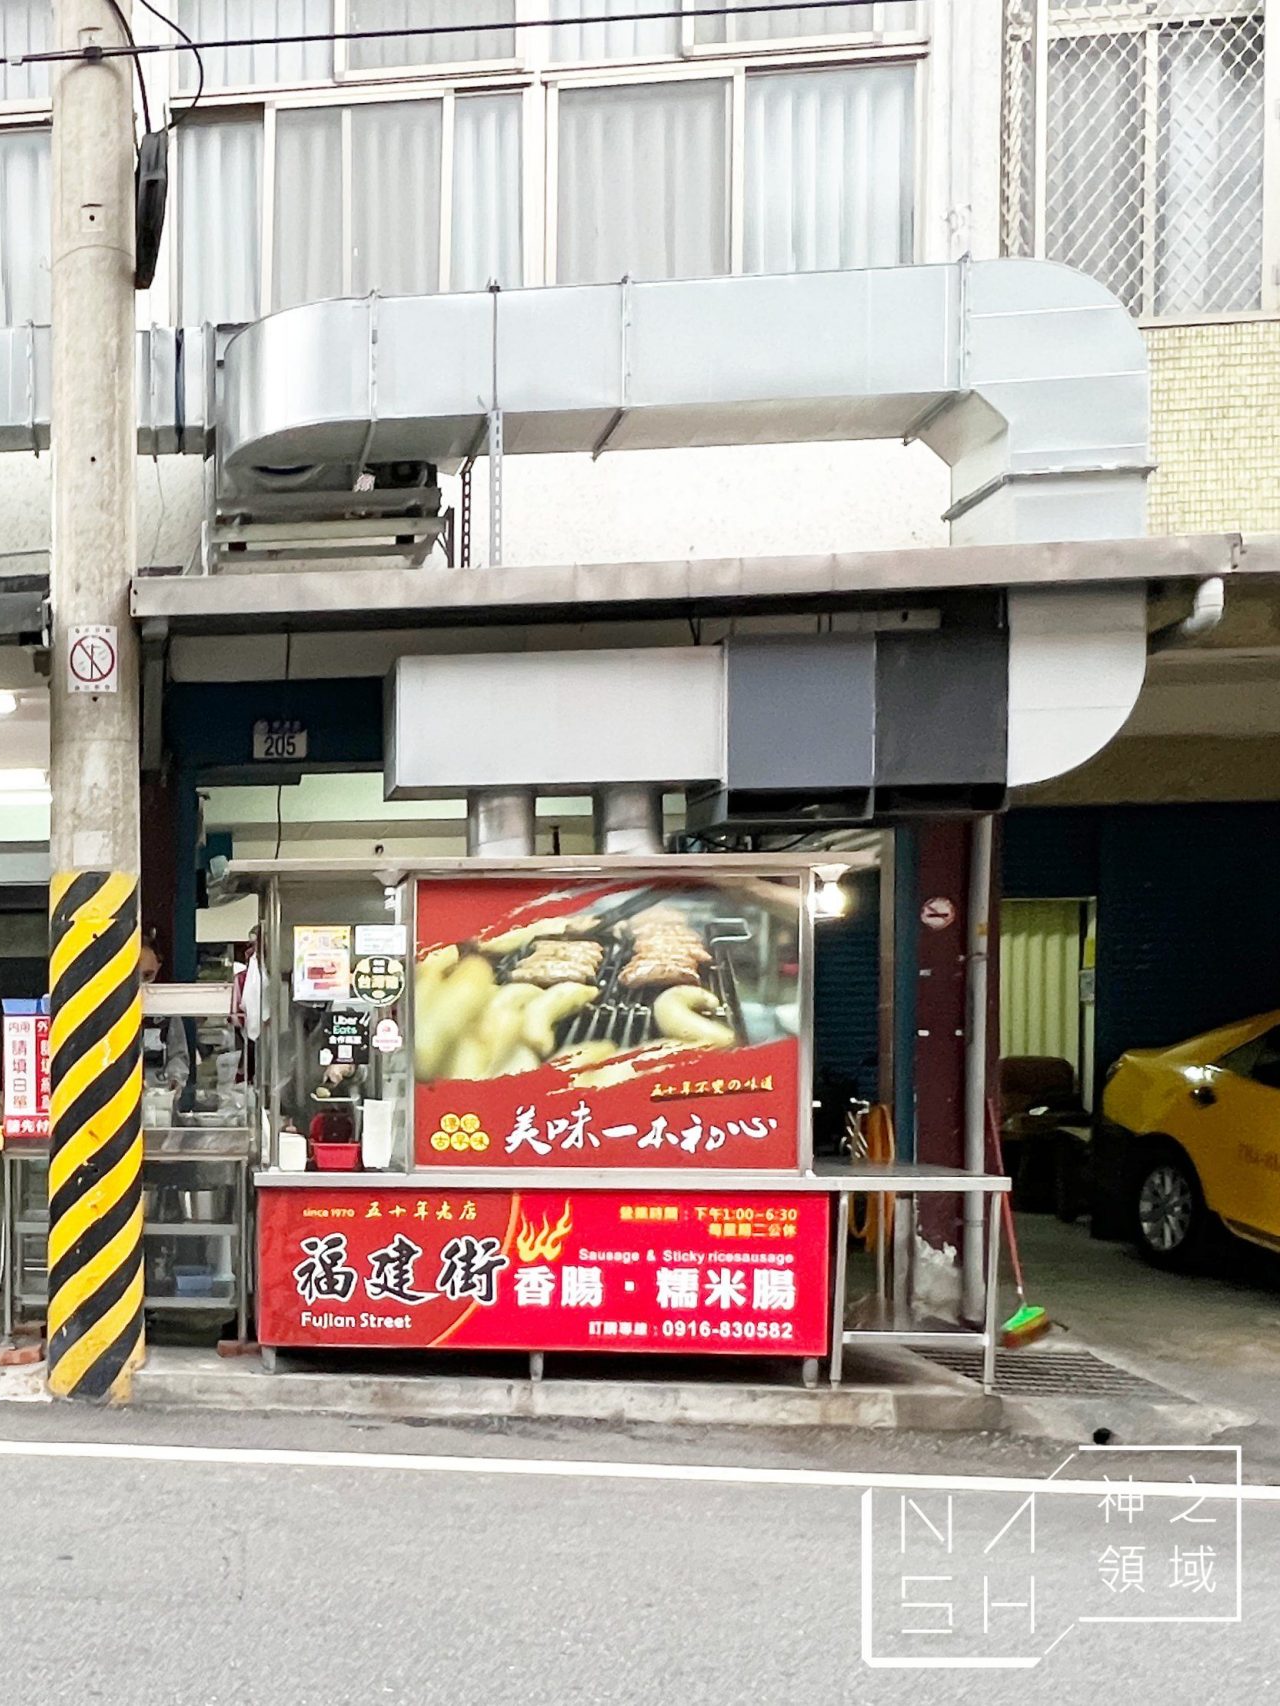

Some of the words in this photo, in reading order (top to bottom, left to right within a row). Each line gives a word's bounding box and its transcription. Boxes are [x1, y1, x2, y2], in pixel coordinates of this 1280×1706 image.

[264, 735, 296, 756] 205
[333, 1015, 358, 1026] Uber
[333, 1025, 358, 1035] Eats
[303, 1208, 329, 1218] since
[331, 1208, 355, 1218] 1970
[365, 1201, 478, 1221] 五十年老店
[579, 1249, 640, 1263] Sausage
[646, 1250, 657, 1262] &
[663, 1250, 705, 1265] Sticky
[708, 1252, 794, 1265] ricesausage
[294, 1233, 509, 1305] 福建街
[301, 1312, 356, 1329] Fujian
[360, 1312, 412, 1329] Street
